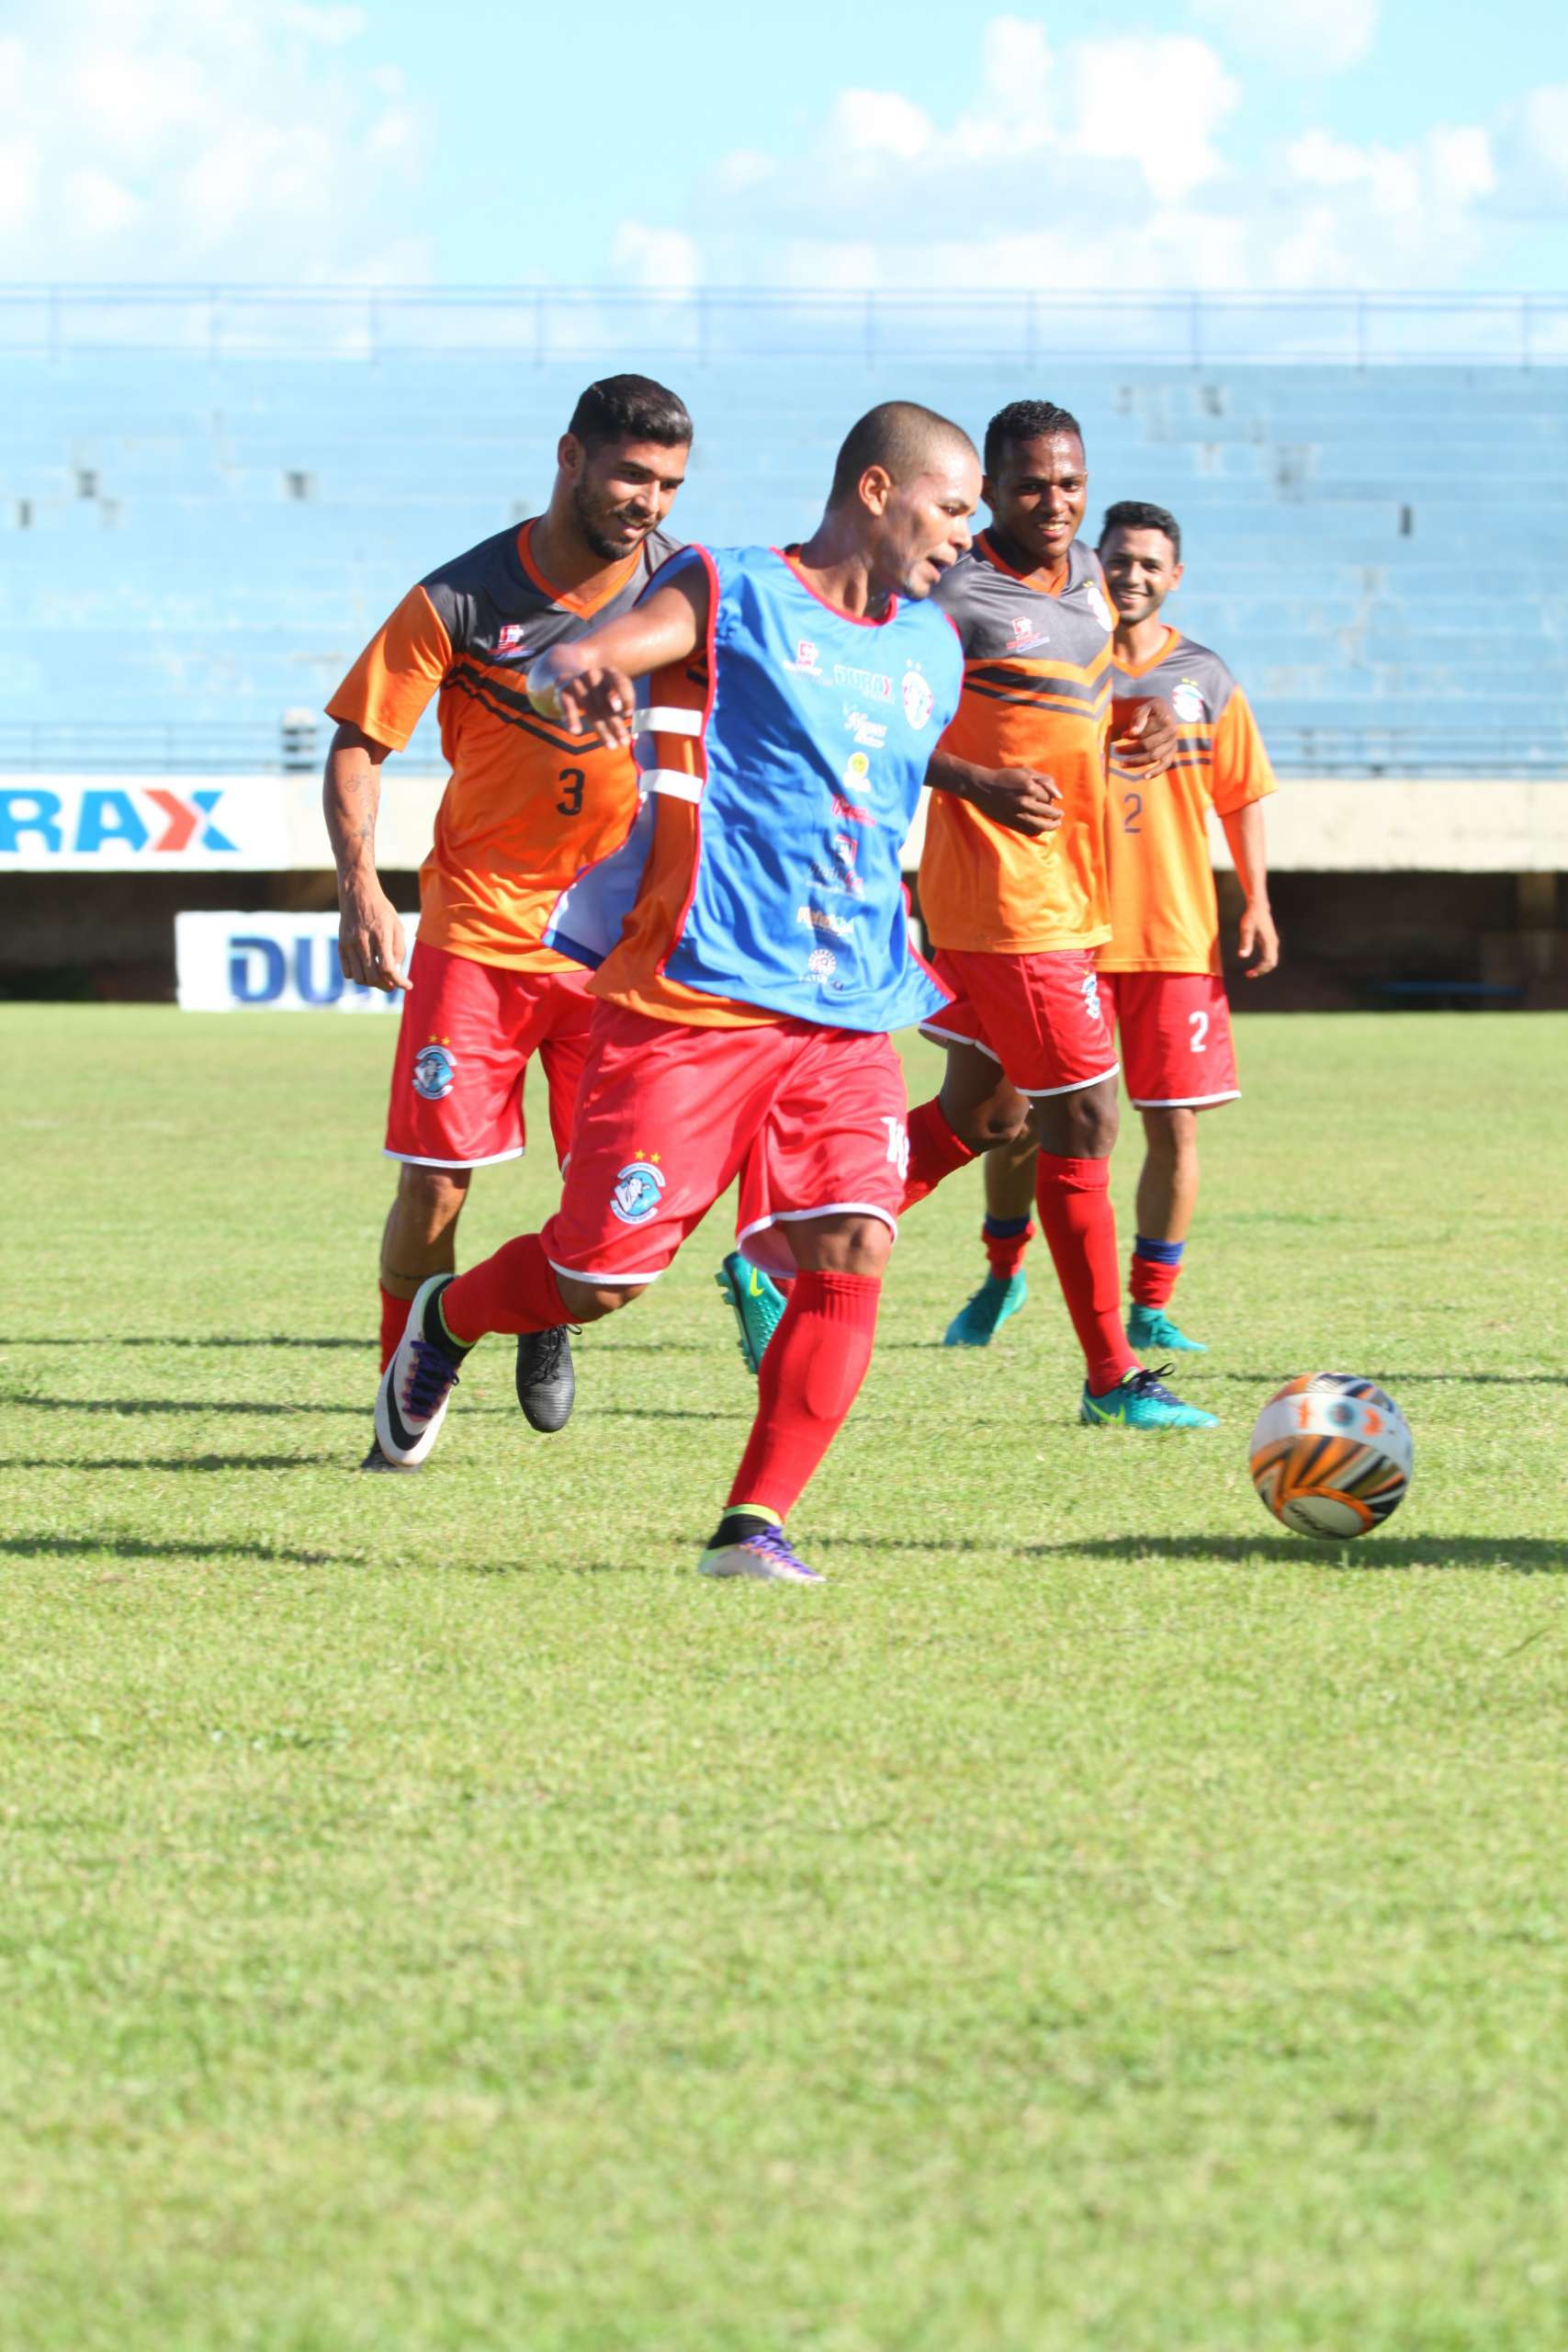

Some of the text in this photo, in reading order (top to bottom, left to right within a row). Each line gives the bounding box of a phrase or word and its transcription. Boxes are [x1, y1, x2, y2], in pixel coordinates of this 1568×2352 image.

[556, 767, 585, 817] 3
[1123, 792, 1143, 834] 2
[0, 788, 241, 853] RAX
[1188, 1011, 1210, 1053] 2
